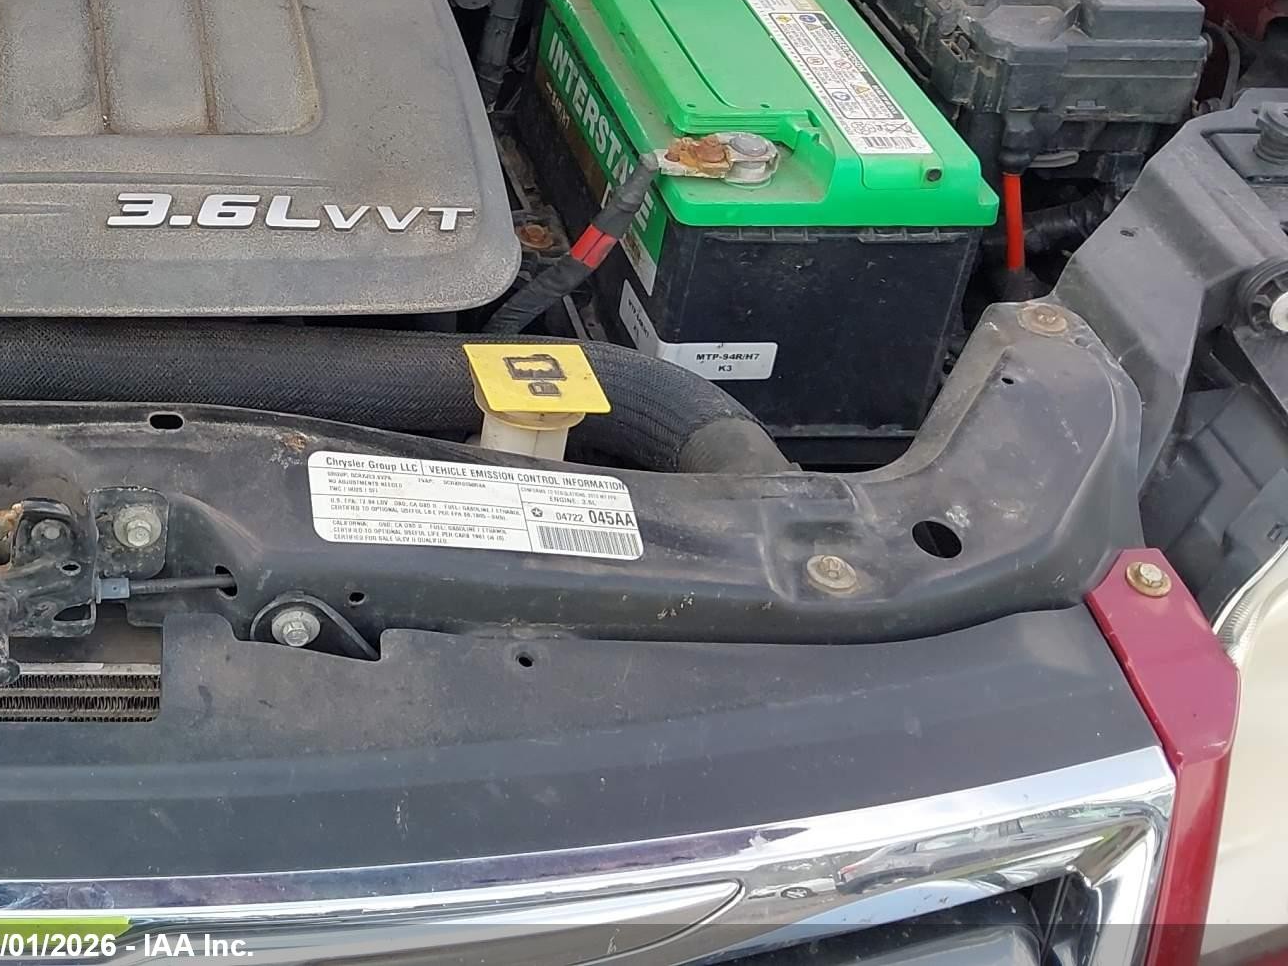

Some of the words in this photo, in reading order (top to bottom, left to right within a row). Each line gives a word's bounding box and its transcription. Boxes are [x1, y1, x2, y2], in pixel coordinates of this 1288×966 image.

[107, 192, 321, 230] 3.6L
[322, 204, 475, 233] VVT
[326, 456, 365, 469] Chrysler
[368, 460, 397, 472] Group
[400, 462, 418, 473] LLC
[429, 465, 468, 477] VEHICLE
[470, 468, 514, 481] EMISSION
[517, 473, 561, 485] CONTROL
[562, 477, 626, 491] INFORMATION
[556, 512, 585, 523] 04722
[588, 509, 636, 527] 045AA
